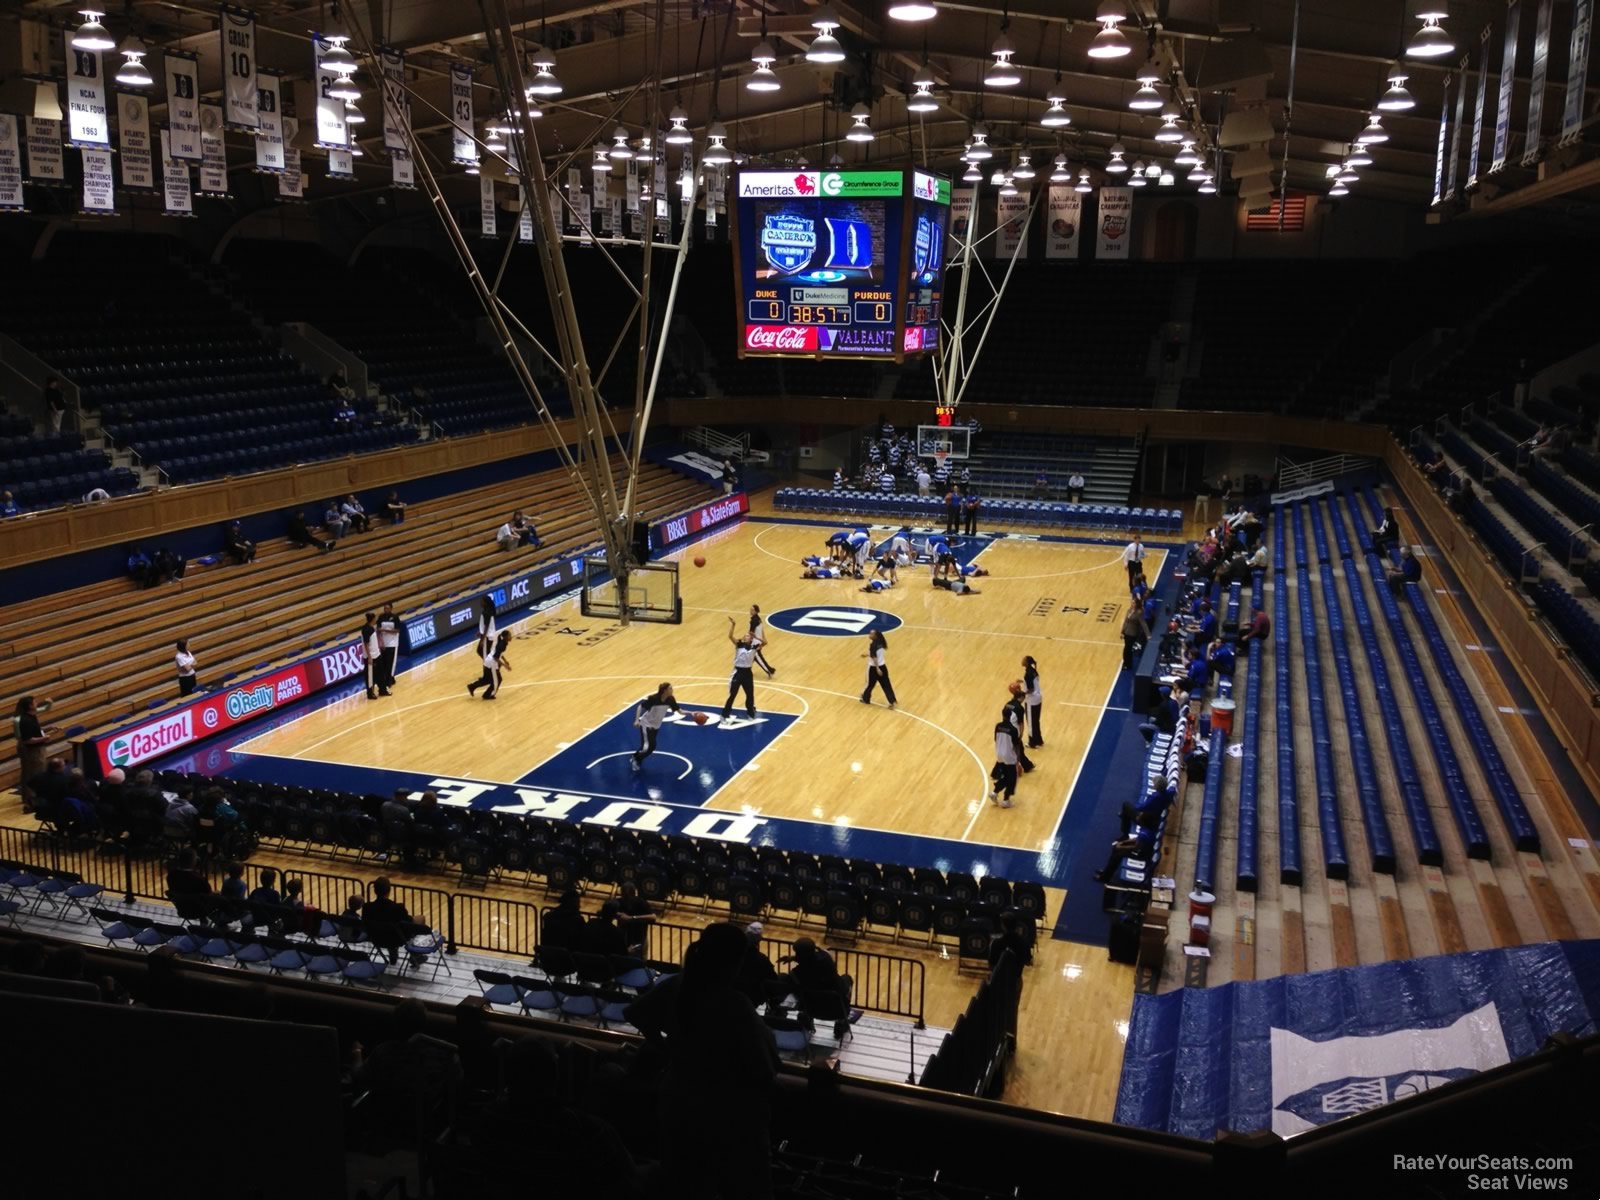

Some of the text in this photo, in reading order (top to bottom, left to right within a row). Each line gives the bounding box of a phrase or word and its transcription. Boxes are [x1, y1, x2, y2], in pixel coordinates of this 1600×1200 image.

[228, 29, 250, 48] GROAT
[231, 52, 250, 78] 10
[80, 88, 96, 99] NCAA
[70, 102, 104, 115] FINAL FOUR
[456, 100, 470, 121] 43
[767, 230, 814, 242] CAMERON
[756, 290, 778, 298] DUKE
[854, 292, 892, 300] PURDUE
[769, 302, 779, 318] 0
[792, 306, 836, 322] 38:57
[875, 304, 885, 320] 0
[748, 326, 808, 348] Coca-Cola
[838, 330, 892, 344] VALEANT
[666, 516, 688, 542] BB&T
[510, 578, 530, 600] ACC
[543, 572, 561, 588] ESPN
[450, 608, 472, 626] ESPN
[408, 620, 435, 644] DICK'S
[320, 642, 366, 686] BB&
[276, 684, 302, 702] PARTS
[277, 676, 298, 692] AUTO
[226, 685, 274, 719] O'Reilly
[202, 707, 218, 728] @
[130, 717, 188, 758] Castrol
[406, 778, 770, 844] DUKE
